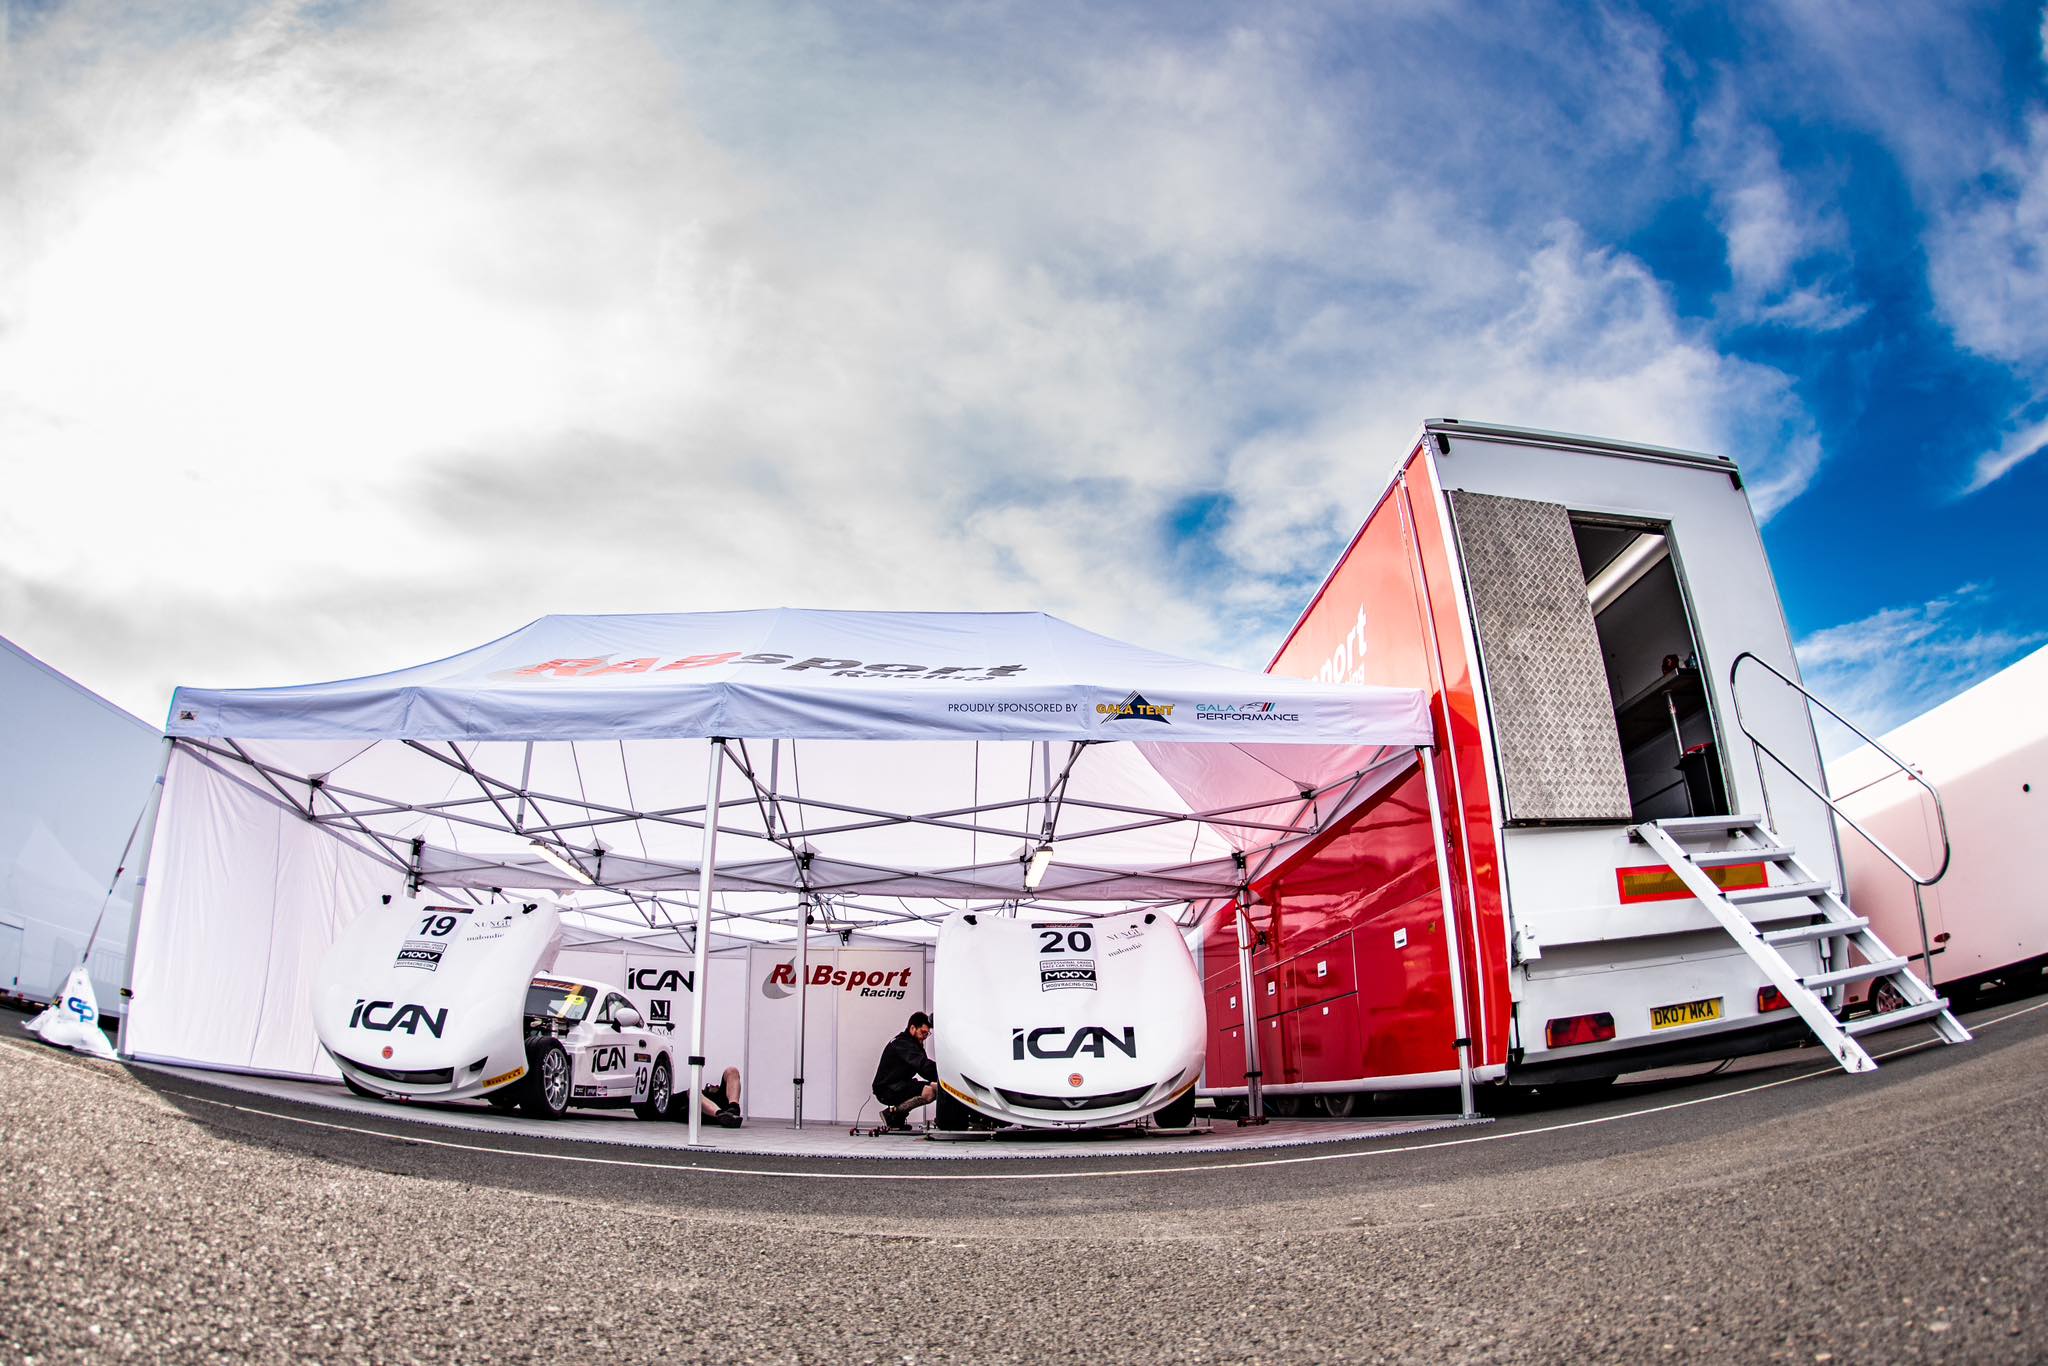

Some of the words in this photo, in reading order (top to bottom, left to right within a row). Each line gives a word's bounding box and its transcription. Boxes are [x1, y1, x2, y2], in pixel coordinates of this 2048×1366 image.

[948, 703, 994, 713] PROUDLY
[997, 703, 1063, 713] SPONSORED
[1065, 703, 1078, 713] BY
[1096, 703, 1134, 715] GALA
[1137, 704, 1174, 716] TENT
[1196, 703, 1236, 712] GALA
[1196, 712, 1299, 722] PERFORMANCE
[419, 914, 457, 937] 19
[1039, 930, 1092, 953] 20
[400, 951, 439, 960] MOOV
[1045, 970, 1092, 980] MOOV
[860, 988, 905, 1000] Racing
[1653, 1006, 1686, 1026] DK07
[1689, 1001, 1714, 1020] MKA
[635, 1066, 648, 1095] 19
